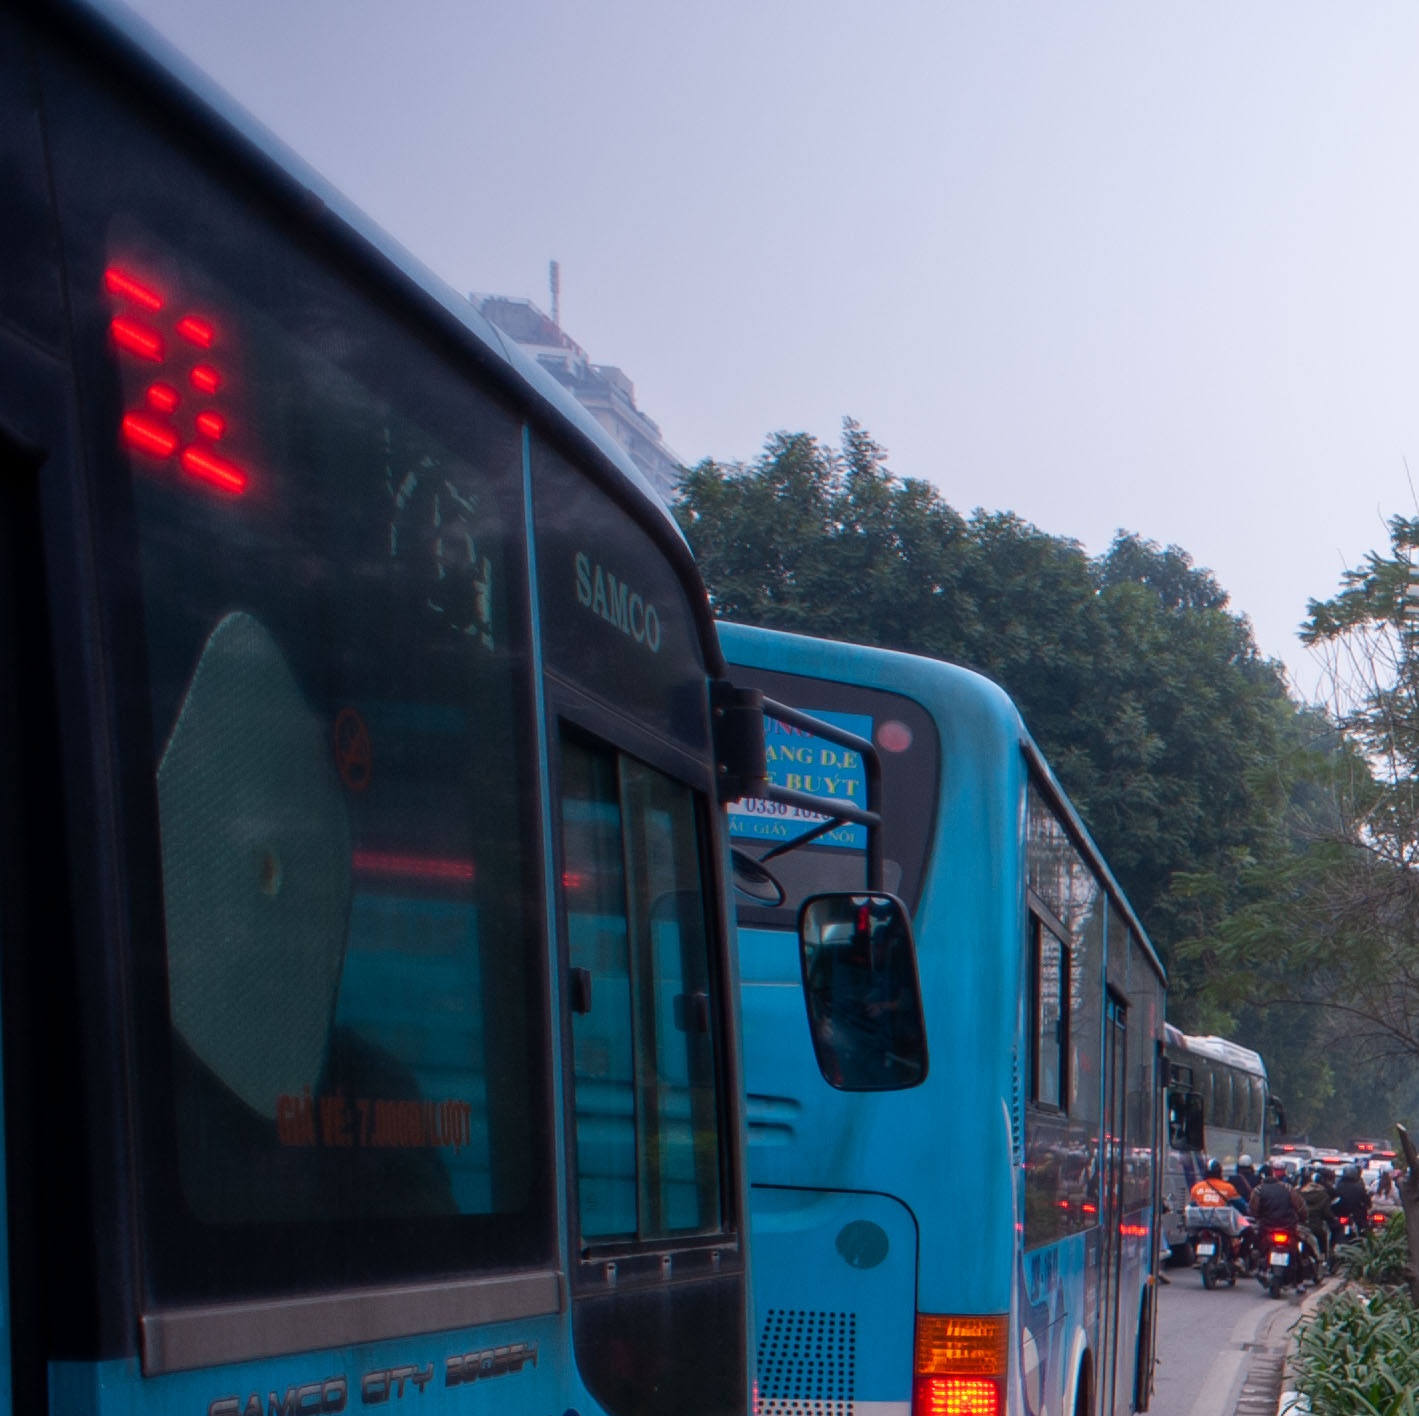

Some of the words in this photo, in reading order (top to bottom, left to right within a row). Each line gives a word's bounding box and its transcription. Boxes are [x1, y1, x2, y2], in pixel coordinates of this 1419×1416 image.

[574, 552, 661, 653] SAMCO
[786, 773, 860, 796] BUÝT
[361, 1362, 433, 1405] CITY
